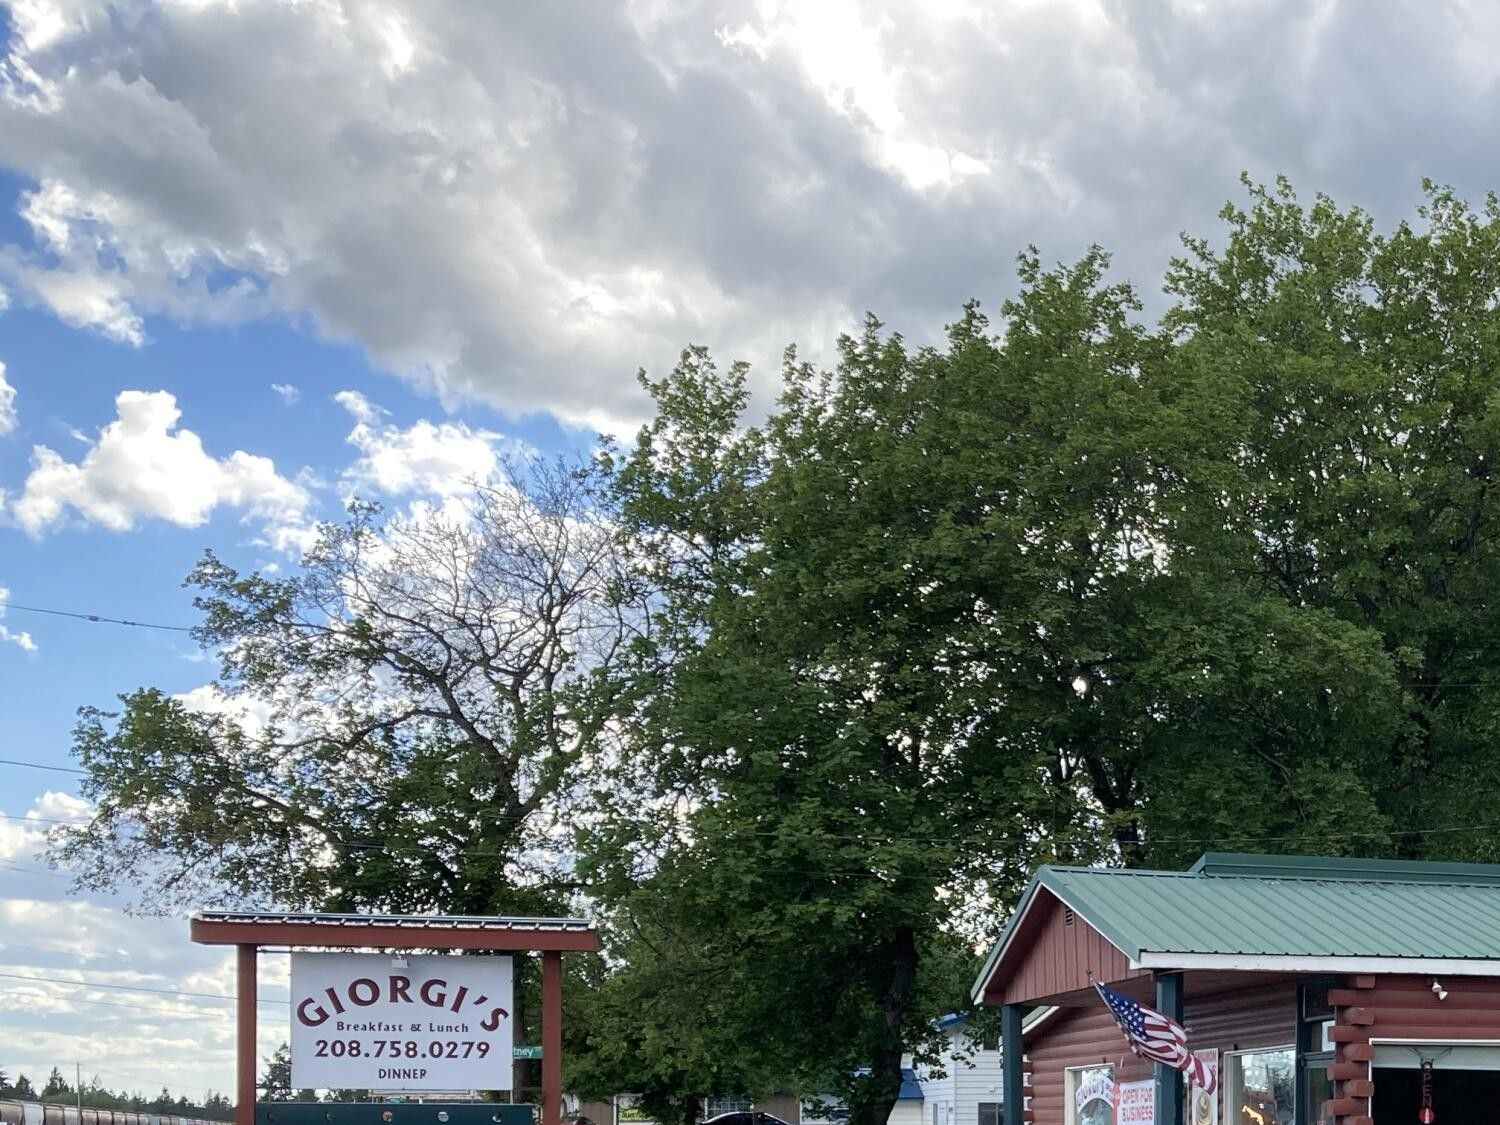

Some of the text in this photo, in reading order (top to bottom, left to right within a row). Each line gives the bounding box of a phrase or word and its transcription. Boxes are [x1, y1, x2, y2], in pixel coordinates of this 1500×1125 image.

[297, 975, 509, 1032] GIORGI'S
[336, 1021, 469, 1033] Breakfast & Lunch
[314, 1040, 490, 1058] 208.758.0279
[378, 1068, 427, 1079] DINNER
[1122, 1088, 1138, 1104] OPEN
[1141, 1087, 1153, 1102] FOR
[1122, 1105, 1153, 1122] BUSINESS
